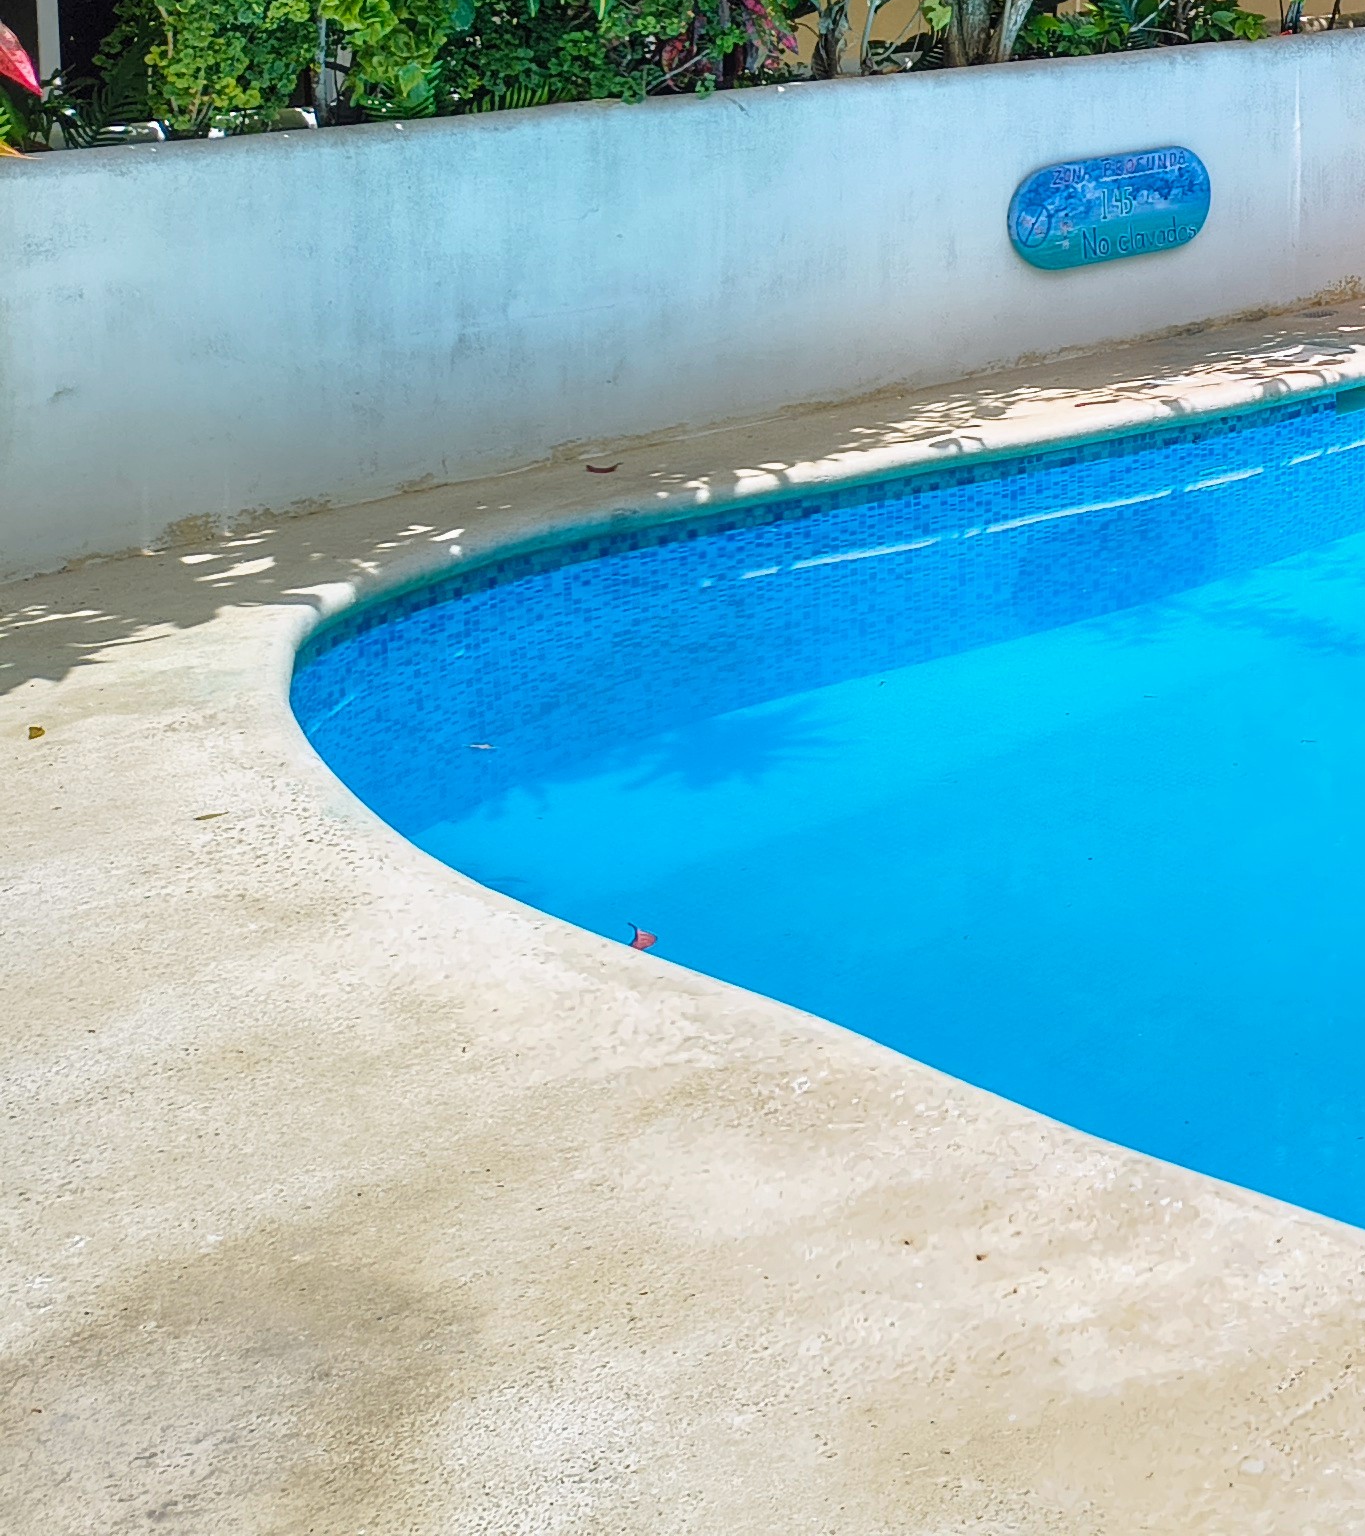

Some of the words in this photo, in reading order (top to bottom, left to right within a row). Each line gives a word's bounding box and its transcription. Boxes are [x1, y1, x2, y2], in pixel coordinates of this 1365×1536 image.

[1100, 151, 1187, 179] PROFUNDA
[1082, 226, 1110, 260] No
[1118, 216, 1198, 253] clavados
